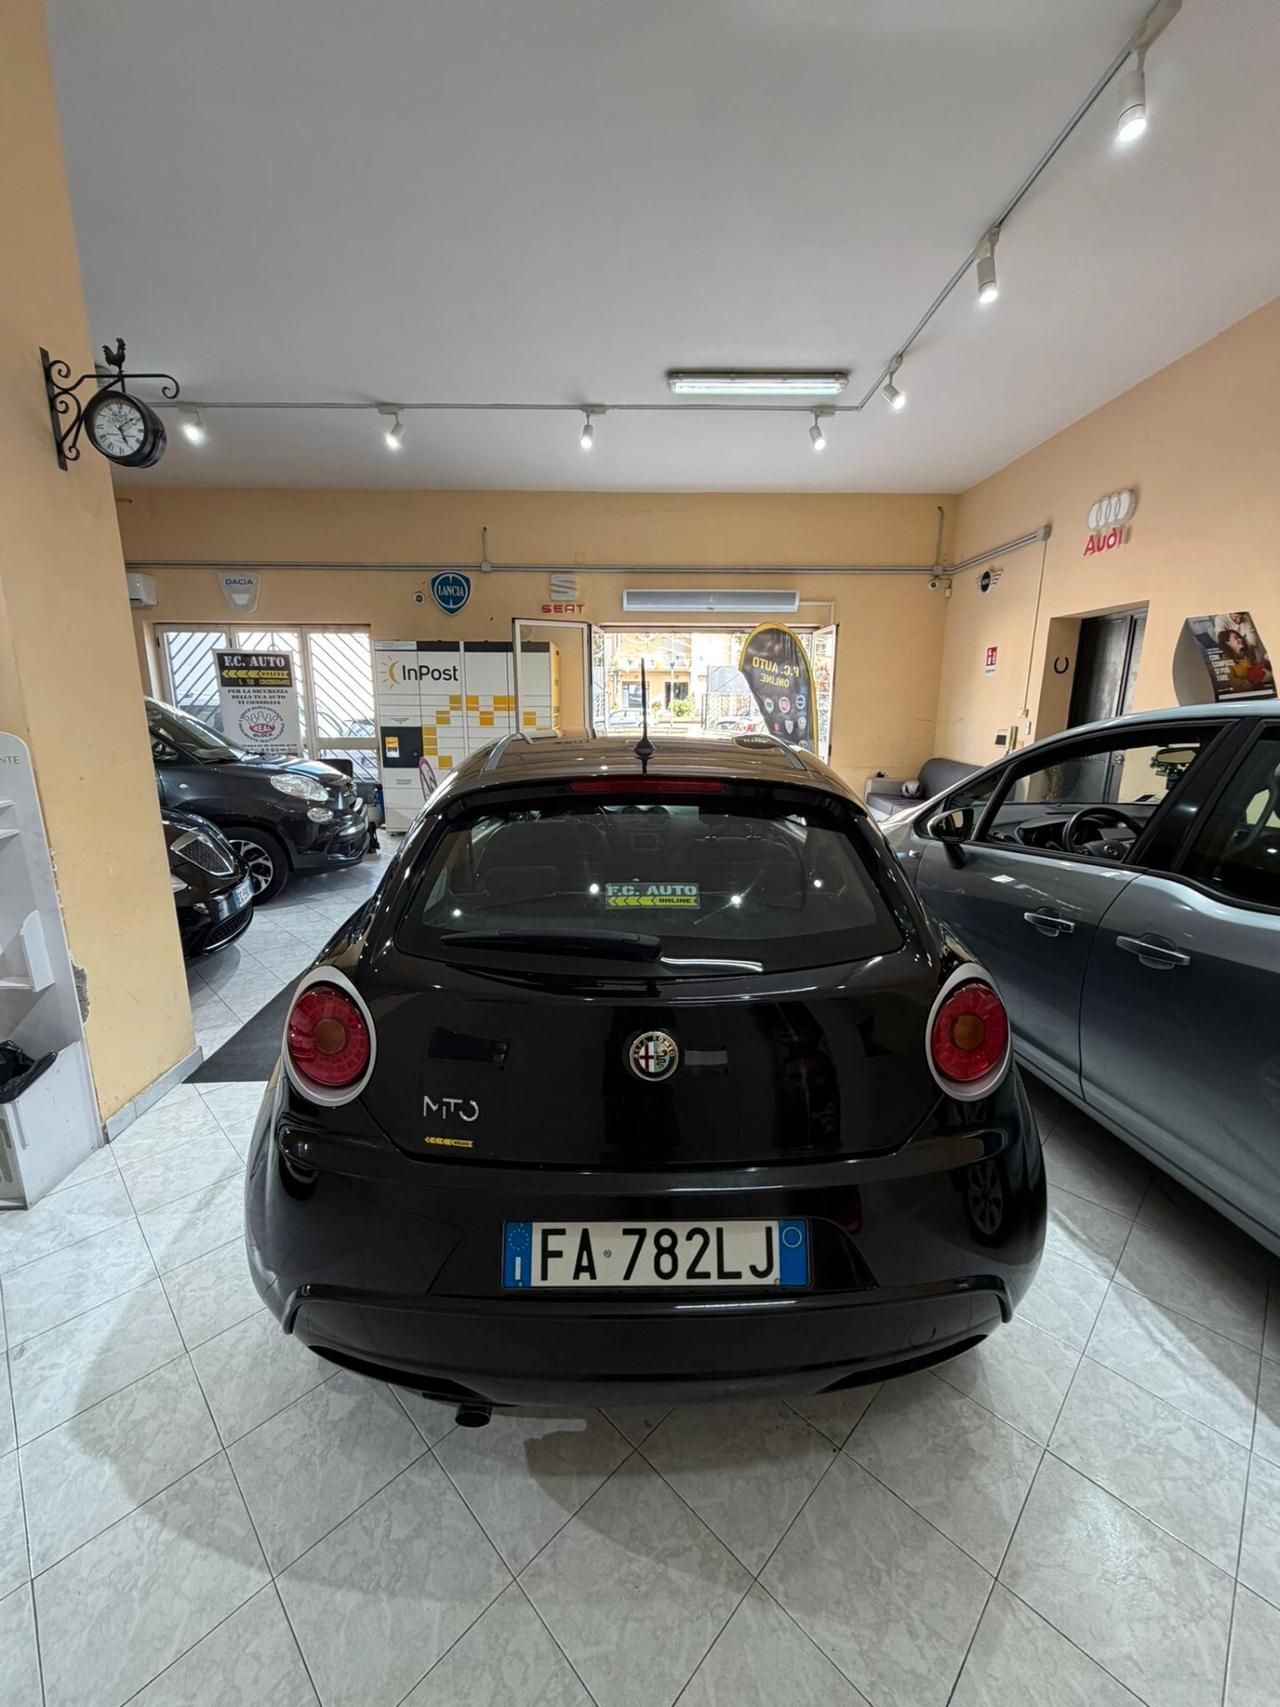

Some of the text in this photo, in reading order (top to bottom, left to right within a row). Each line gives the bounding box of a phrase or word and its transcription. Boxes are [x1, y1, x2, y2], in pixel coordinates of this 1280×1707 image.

[1083, 527, 1123, 556] Audi
[438, 585, 464, 597] LANCIA
[541, 604, 585, 614] SEAT
[223, 655, 286, 667] F.C. AUTO
[402, 665, 459, 682] InPost
[253, 724, 273, 732] REAL
[607, 885, 697, 896] F.C. AUTO
[514, 1226, 774, 1281] I FA 782LJ
